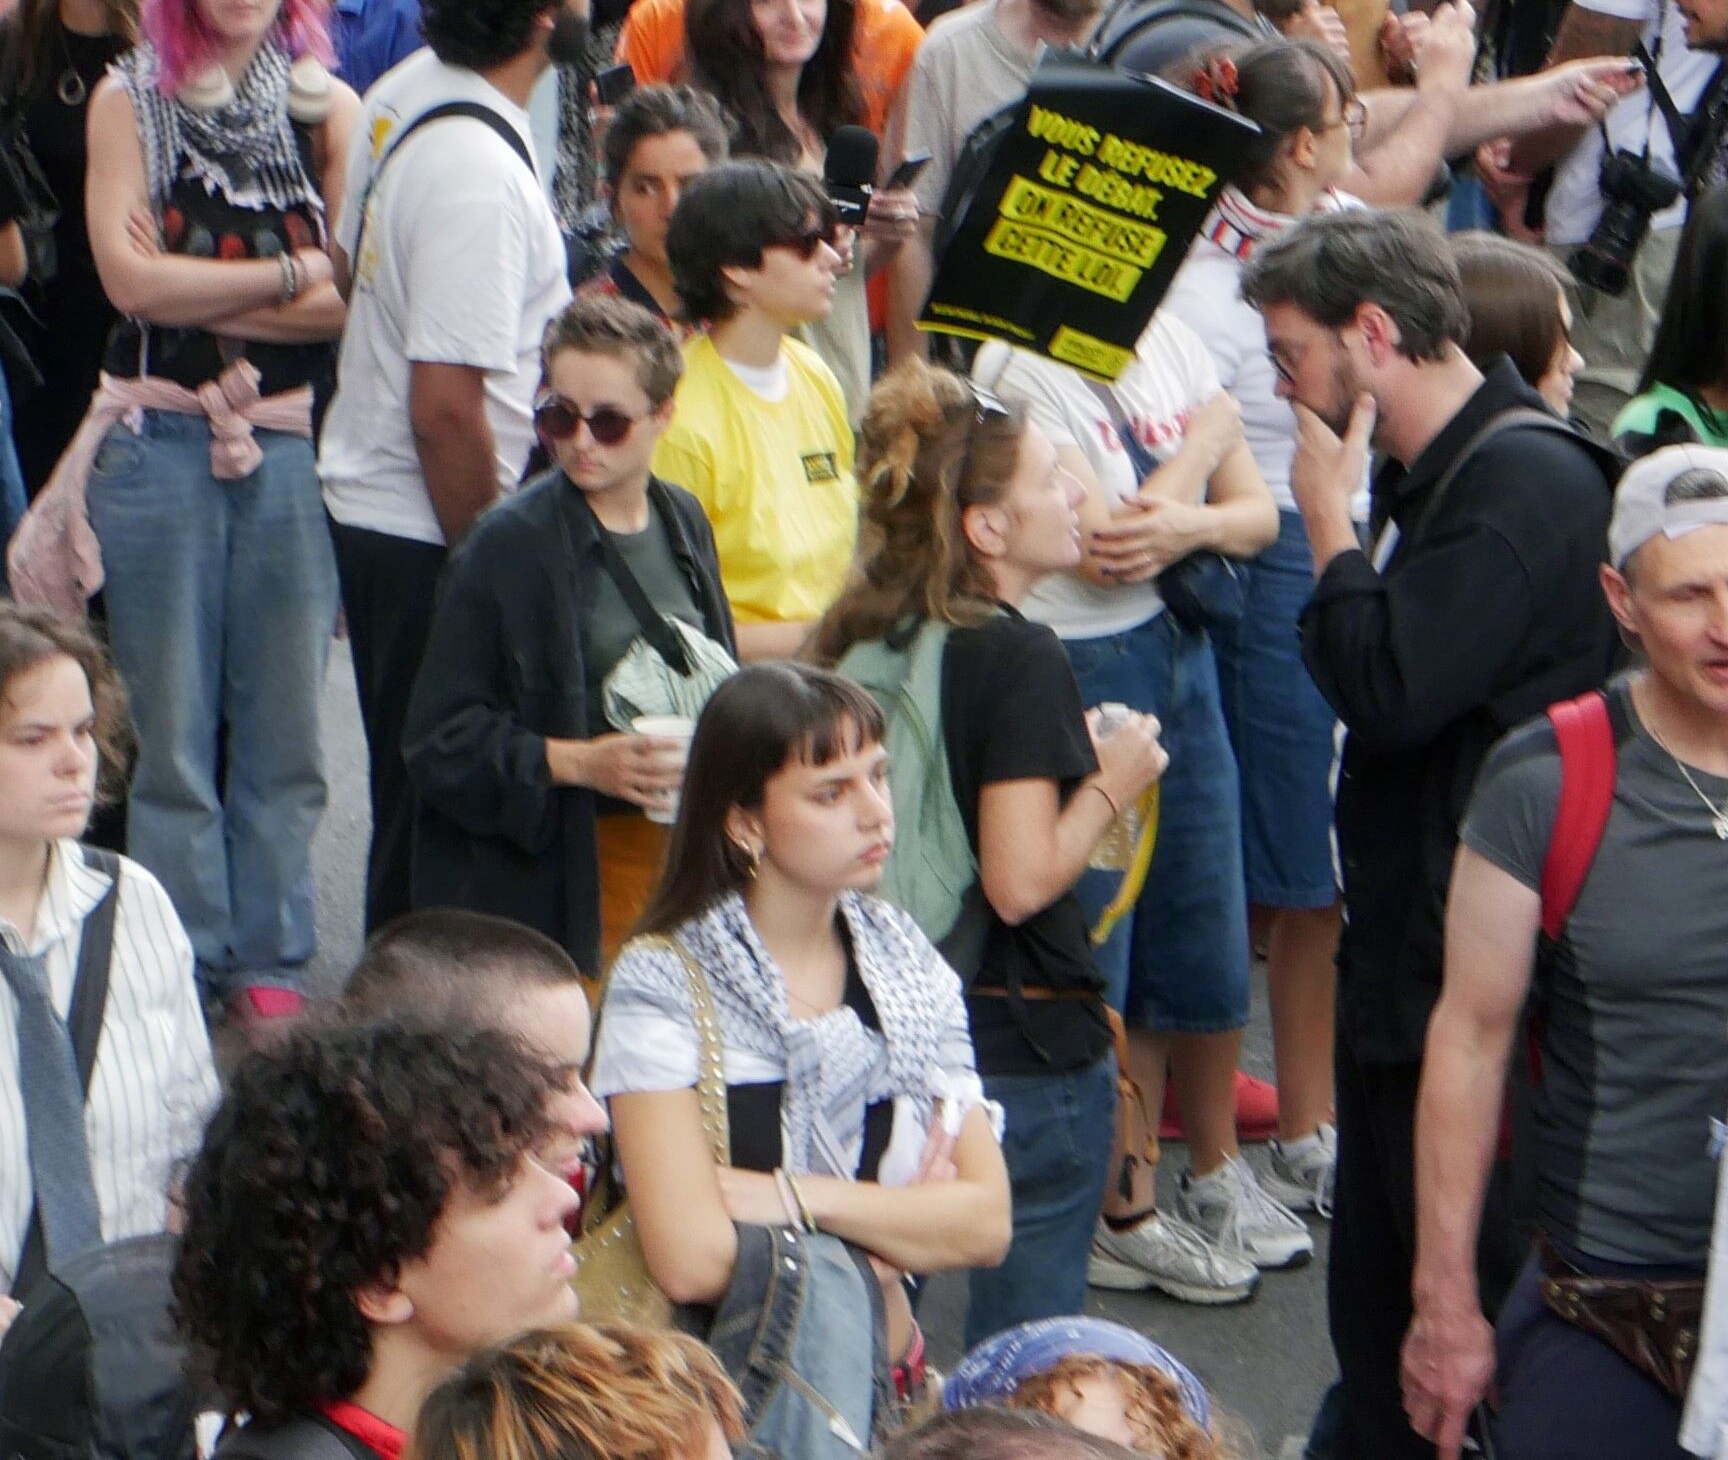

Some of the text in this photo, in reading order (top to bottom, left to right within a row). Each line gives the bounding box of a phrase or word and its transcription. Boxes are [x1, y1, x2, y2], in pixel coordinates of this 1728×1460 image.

[1028, 104, 1218, 199] VOUS REFUSEZ
[1038, 148, 1081, 188] LE
[999, 226, 1078, 273] CETTE
[1015, 187, 1152, 262] ON REFUSE
